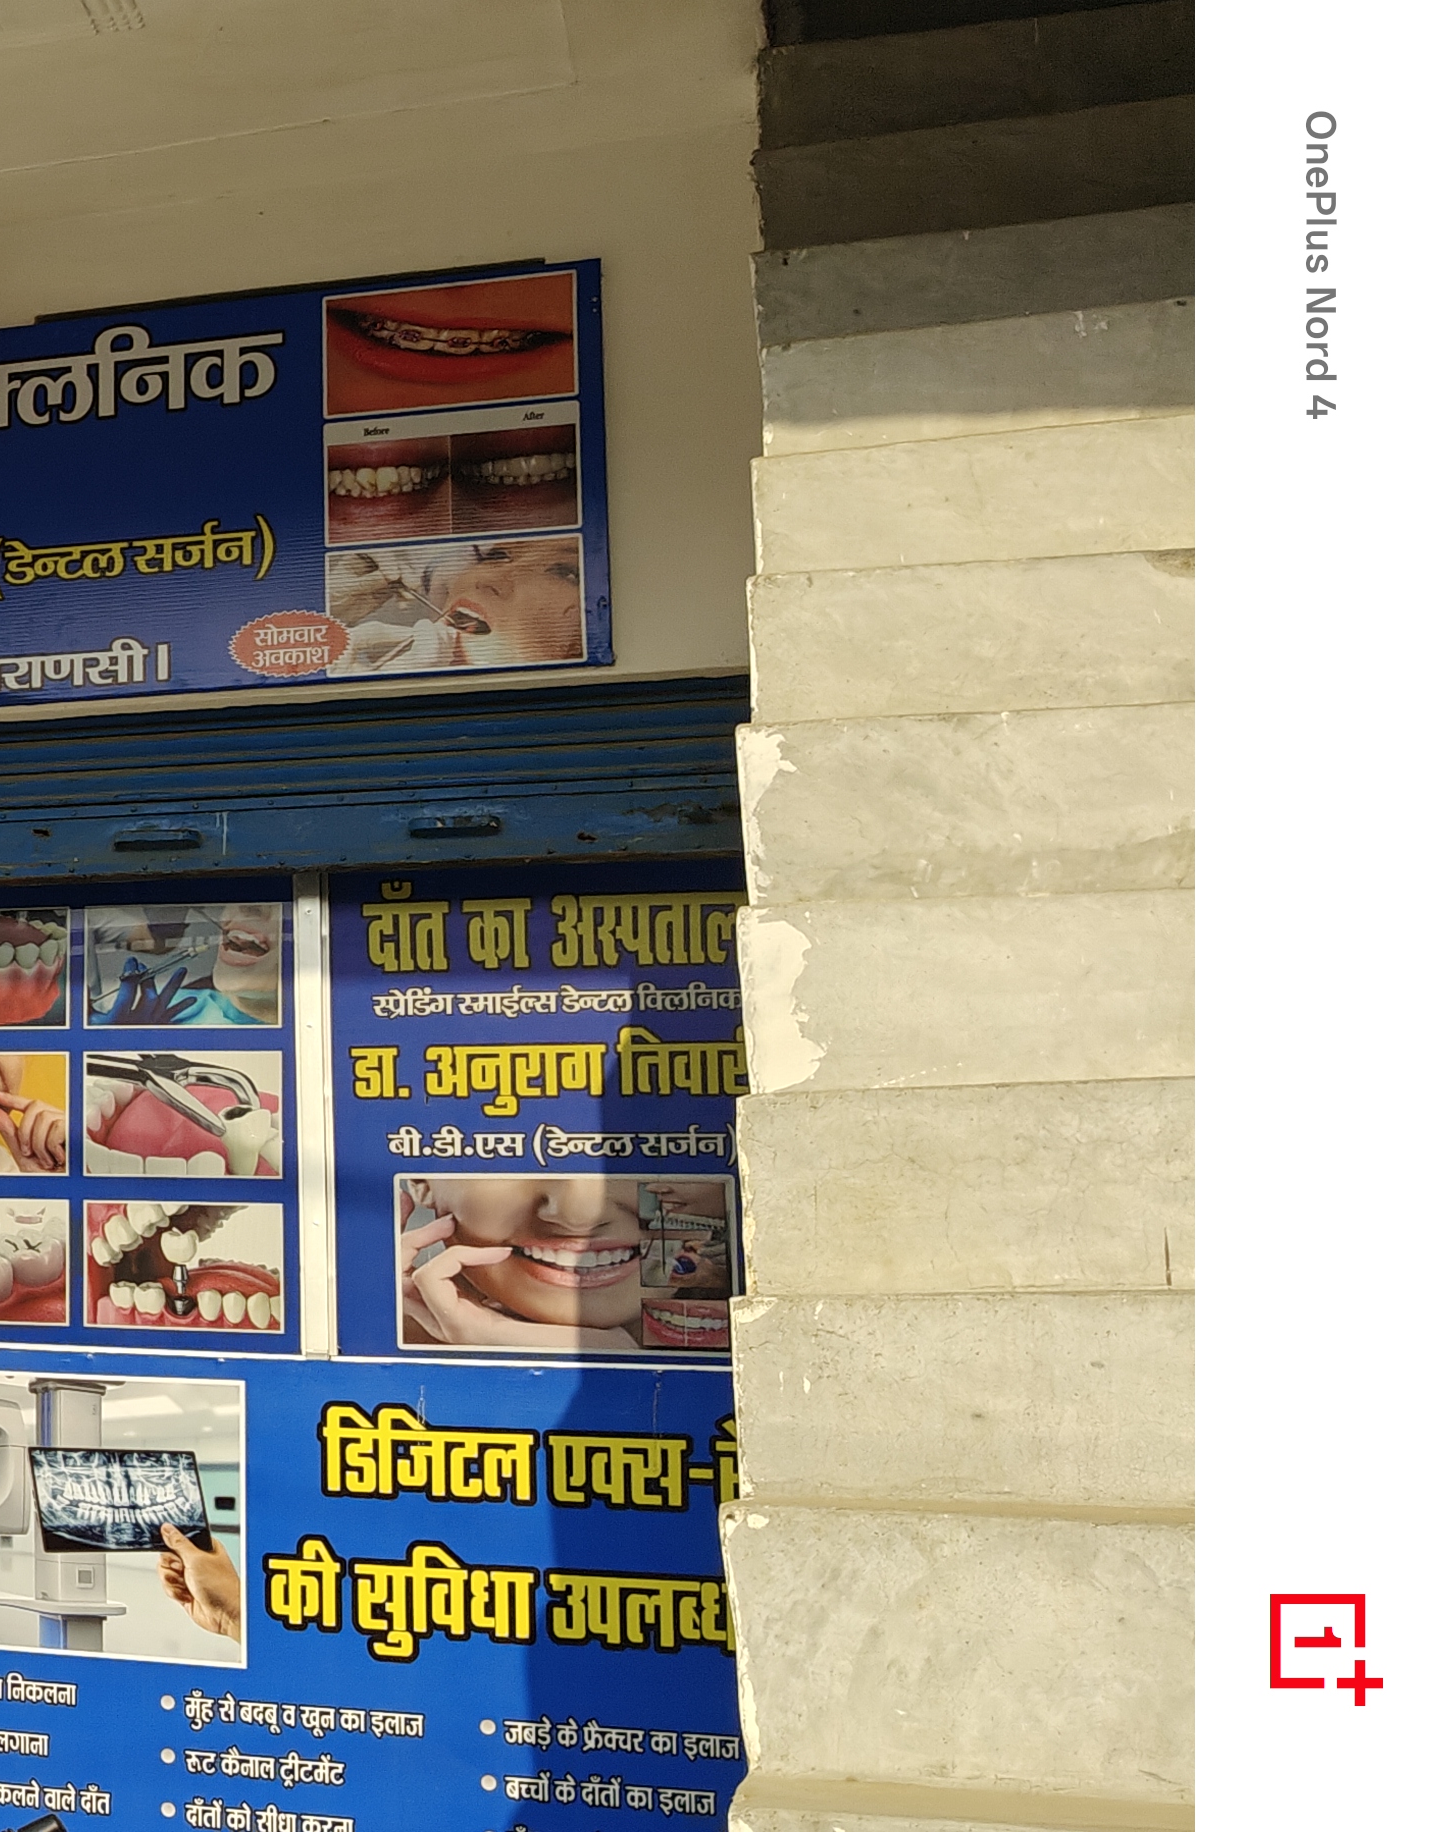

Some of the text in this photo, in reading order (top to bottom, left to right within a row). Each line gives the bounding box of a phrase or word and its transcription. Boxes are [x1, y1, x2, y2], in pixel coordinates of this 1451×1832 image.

[133, 515, 277, 583] सर्जन)
[253, 622, 329, 647] सोमवार
[251, 644, 331, 670] अवकाश
[462, 896, 532, 969] का
[372, 987, 454, 1019] स्प्रेडिंग
[457, 984, 557, 1018] स्माईल्स
[560, 984, 633, 1013] डेन्टल
[350, 1026, 749, 1117] डा. अनुराग तिवार
[387, 1122, 737, 1166] बी.डी.एस (डेन्टल सर्जन)
[320, 1404, 536, 1502] डिजिटल
[266, 1538, 736, 1658] की सुविधा उपलब्ध
[6, 1672, 77, 1706] निकलना
[218, 1692, 236, 1723] से
[239, 1700, 281, 1735] बदबू
[282, 1704, 297, 1728] व
[300, 1705, 336, 1738] खून
[340, 1707, 367, 1733] का
[370, 1711, 425, 1739] इलाज
[503, 1716, 552, 1750] जबड़े
[556, 1718, 579, 1747] के
[650, 1731, 678, 1755] का
[683, 1733, 740, 1760] इलाज
[185, 1746, 346, 1788] रूट कैनाल ट्रीटमेंट
[44, 1783, 77, 1813] वाले
[504, 1771, 551, 1803] बच्चों
[555, 1774, 577, 1804] के
[626, 1785, 654, 1810] का
[658, 1788, 716, 1816] इलाज
[226, 1802, 251, 1831] को
[255, 1804, 297, 1832] सीधा
